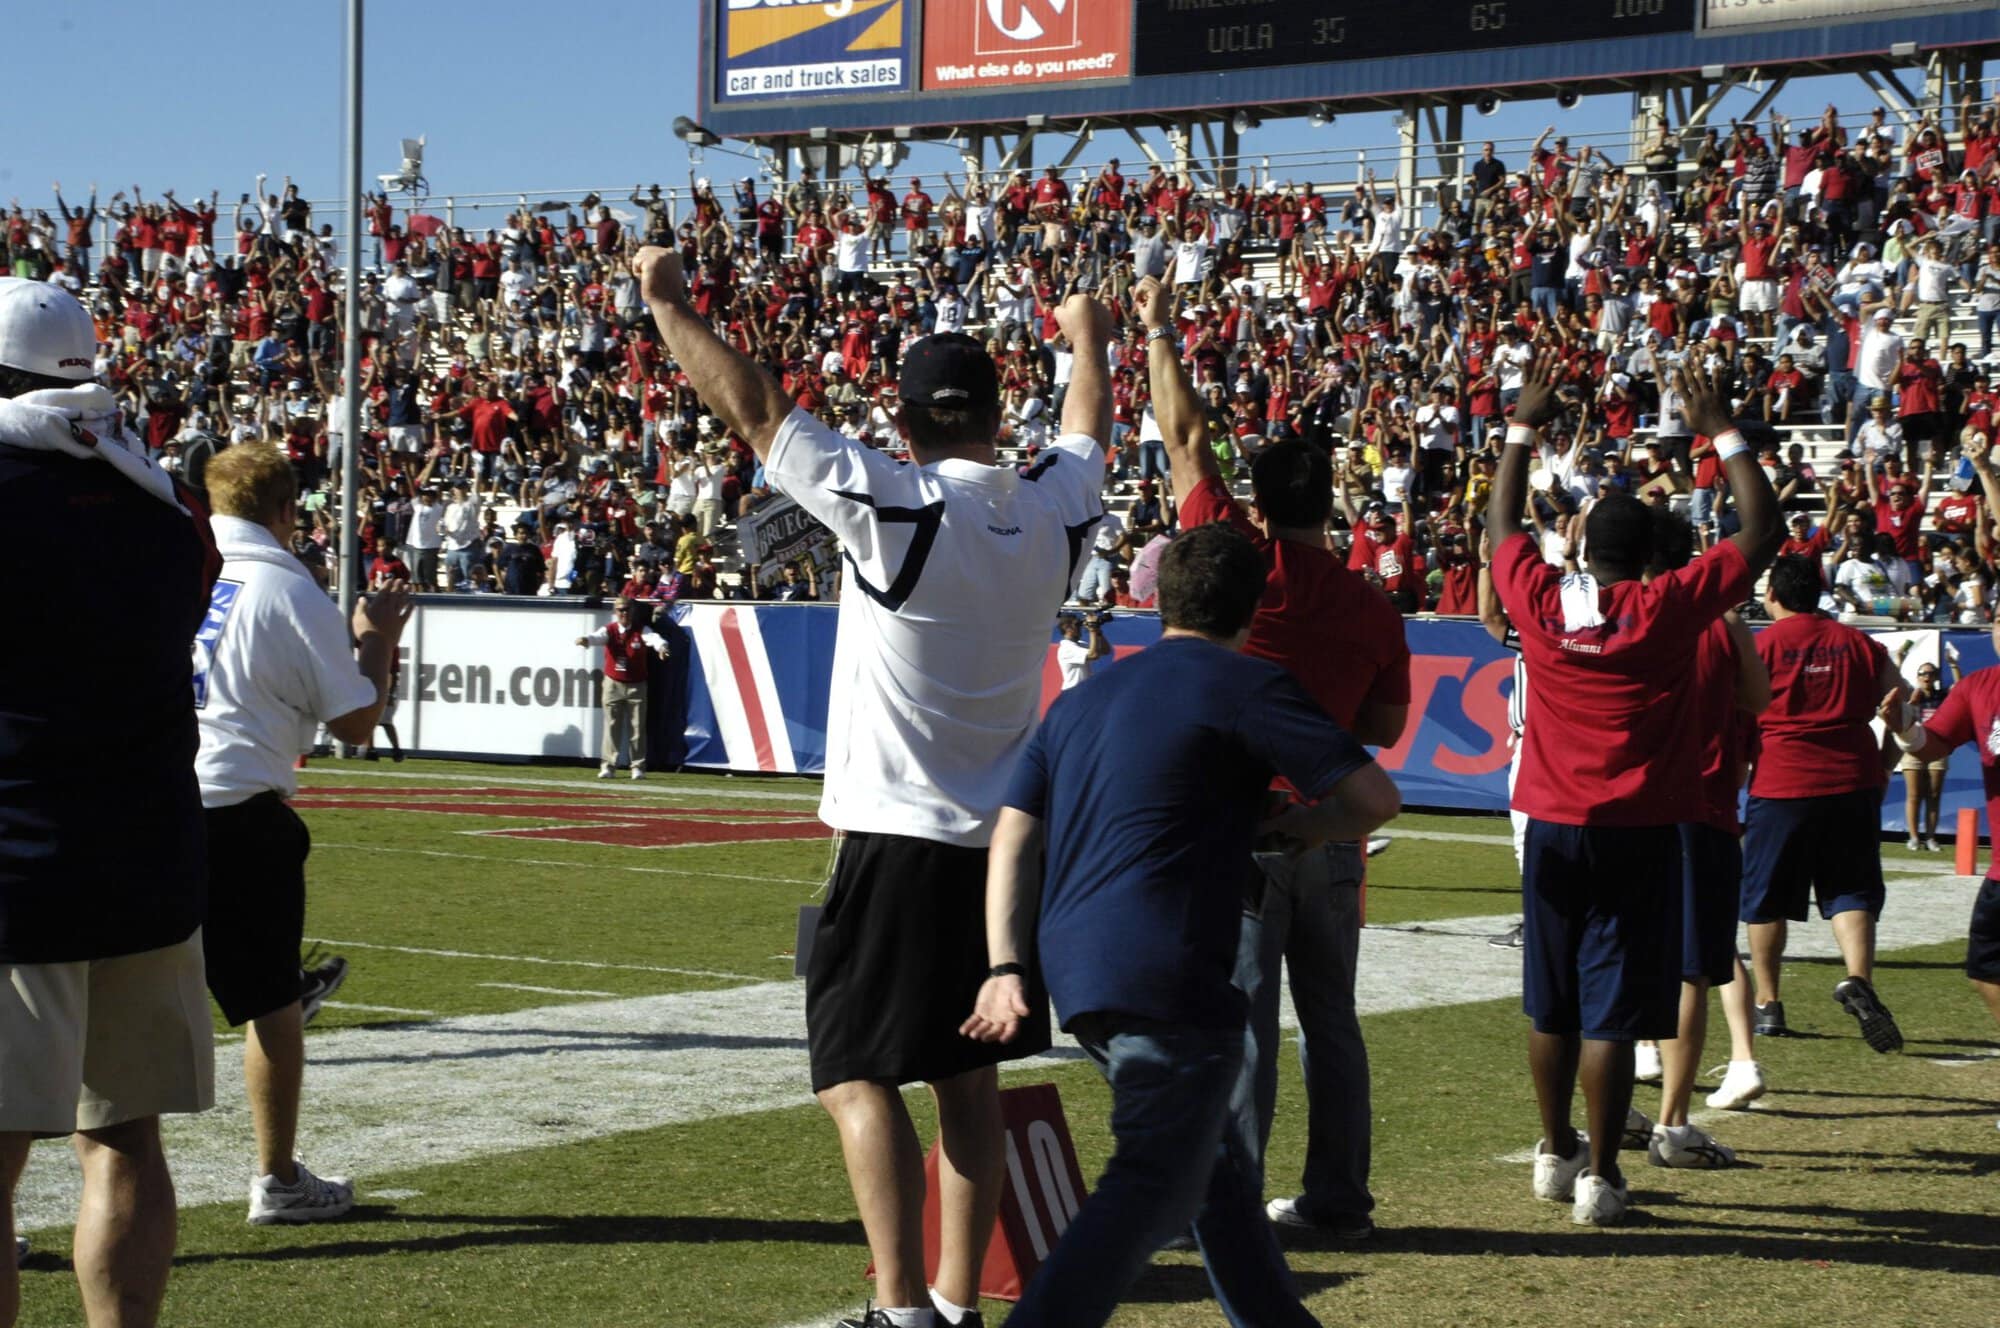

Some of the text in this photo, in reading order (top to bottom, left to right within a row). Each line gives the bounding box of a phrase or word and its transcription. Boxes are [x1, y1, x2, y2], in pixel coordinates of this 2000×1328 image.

[1208, 23, 1273, 53] UCLA
[1312, 16, 1346, 45] 35
[1470, 3, 1507, 31] 65
[730, 64, 897, 92] car and truck sales
[936, 53, 1116, 81] What else do you need?
[1558, 638, 1602, 654] Alumni
[397, 647, 603, 709] izen.com
